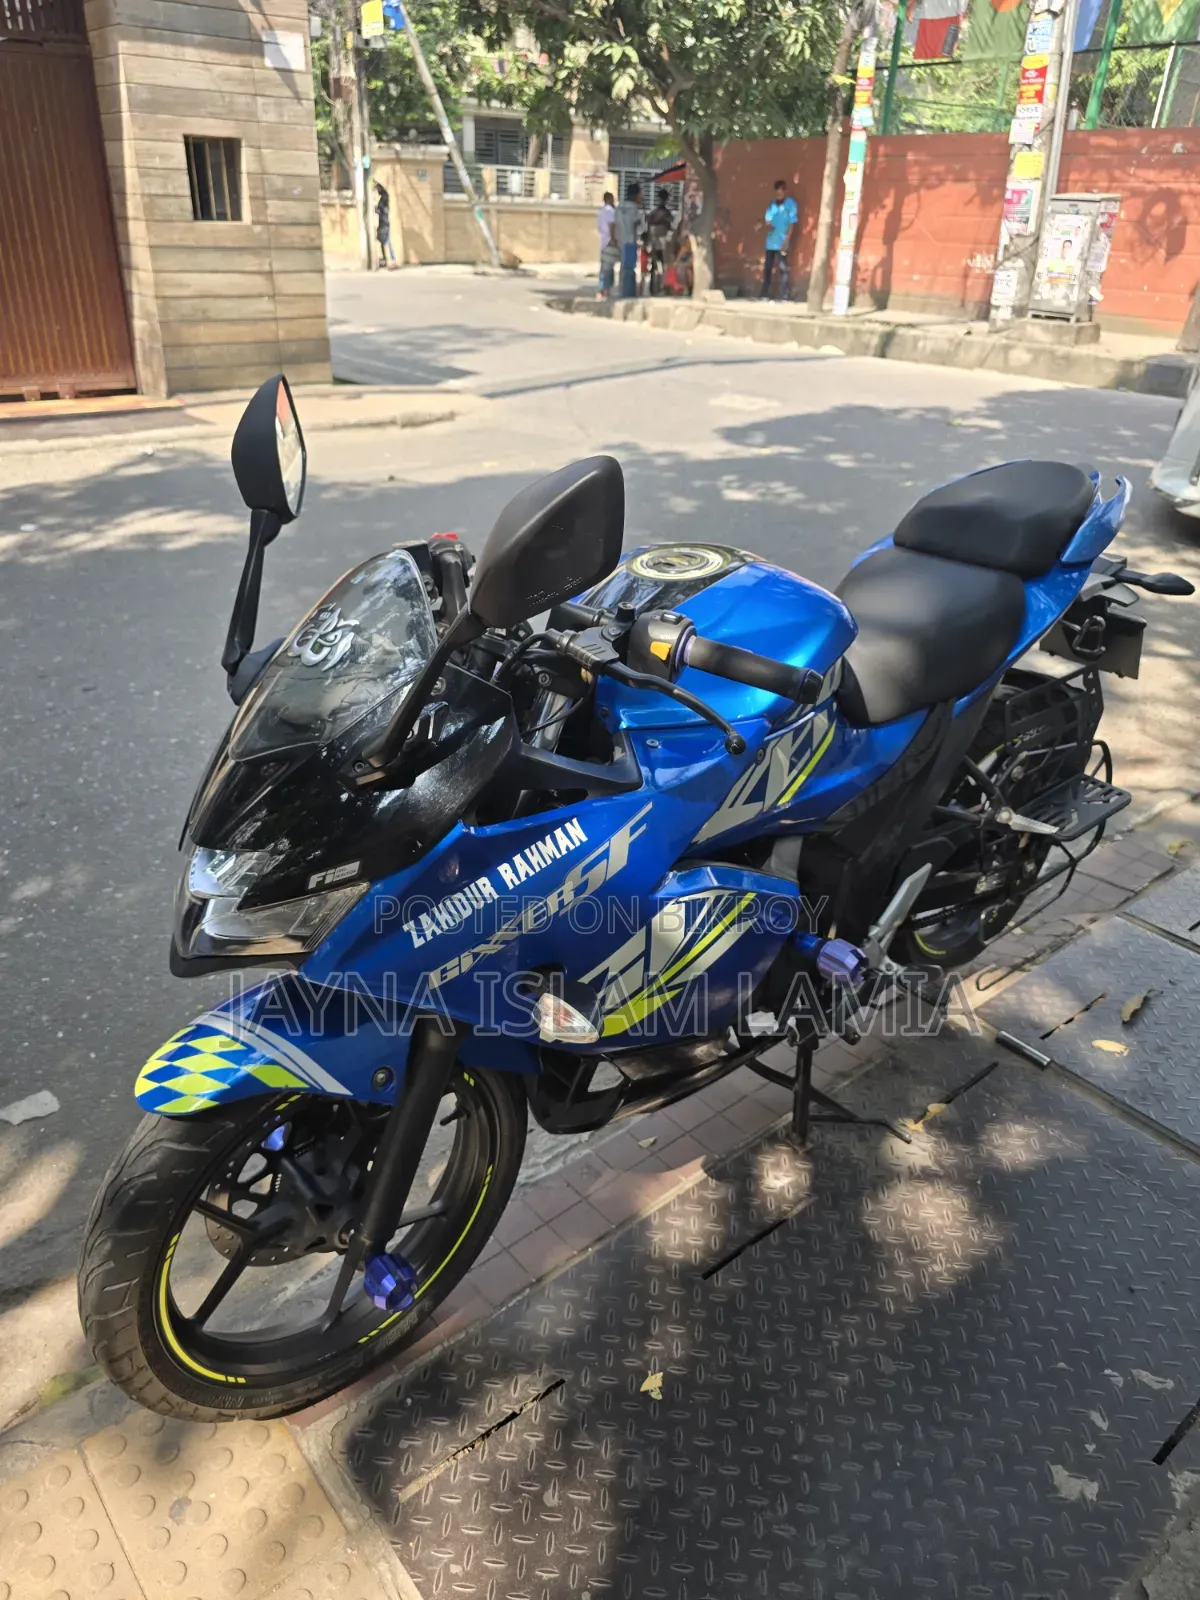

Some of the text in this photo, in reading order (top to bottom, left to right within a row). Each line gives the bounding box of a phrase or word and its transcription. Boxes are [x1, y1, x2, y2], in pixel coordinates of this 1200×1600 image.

[307, 868, 336, 890] Fi
[496, 817, 589, 891] RAHMAN
[428, 880, 575, 991] GIXXER
